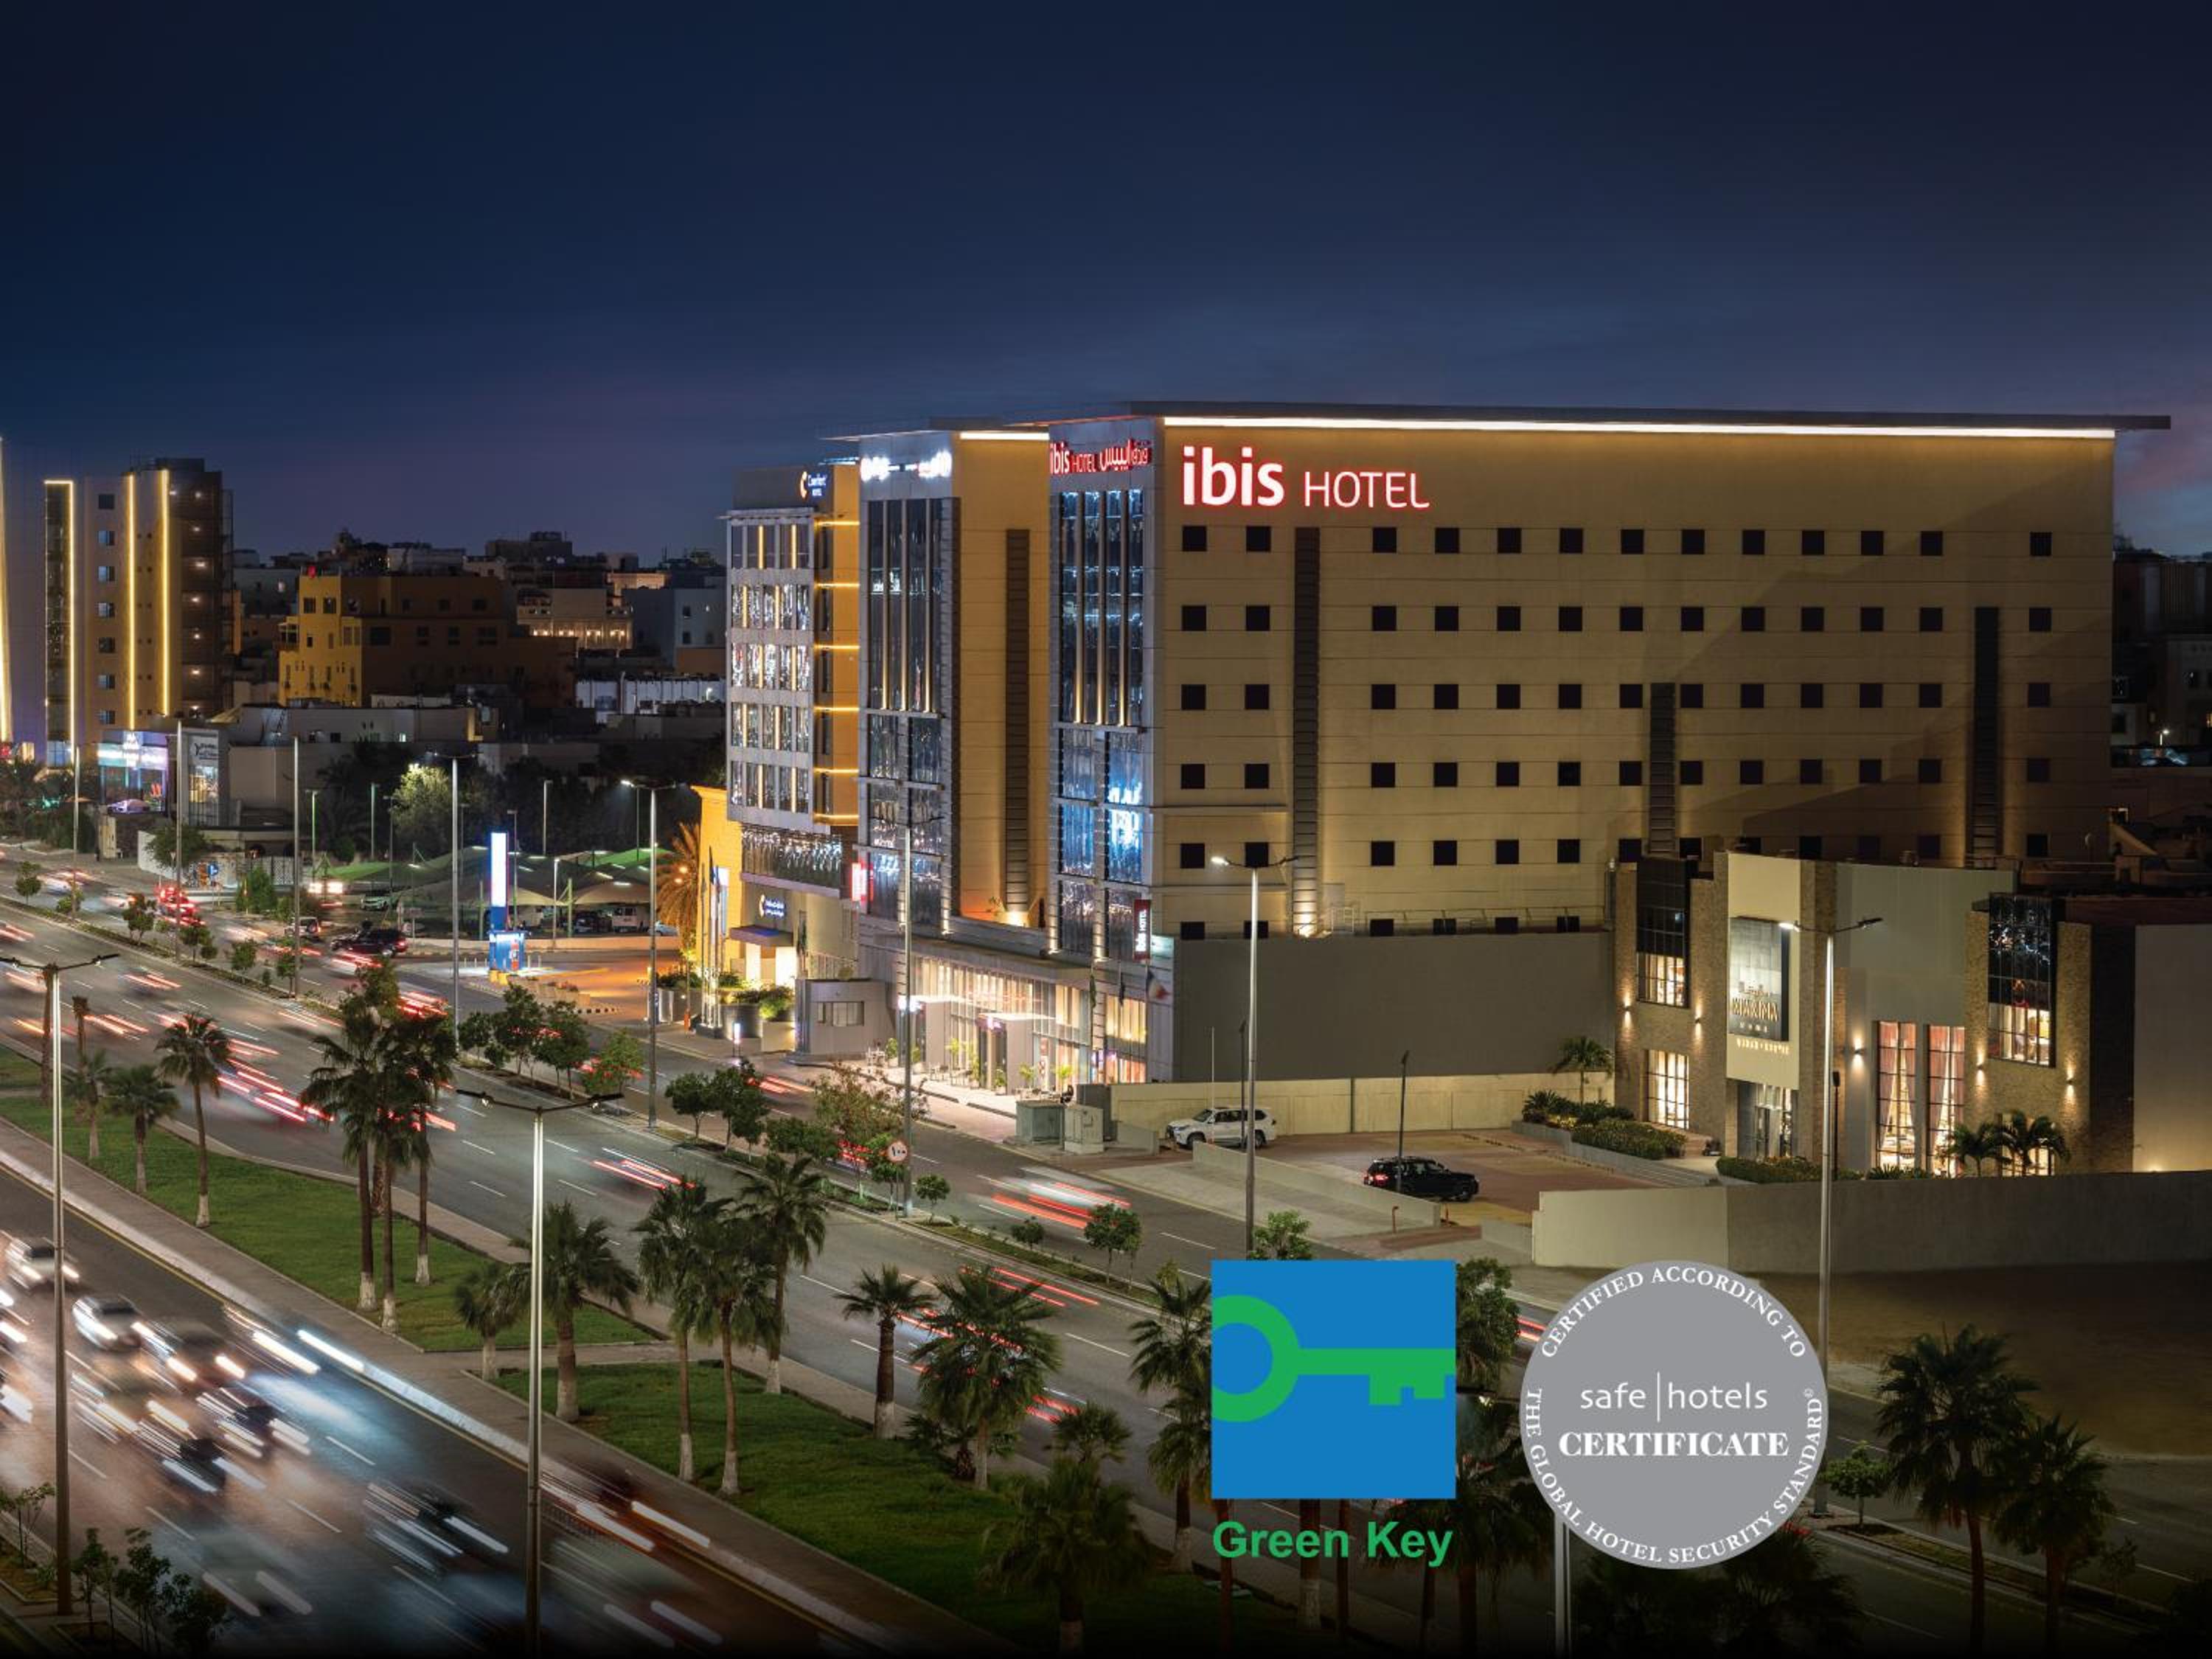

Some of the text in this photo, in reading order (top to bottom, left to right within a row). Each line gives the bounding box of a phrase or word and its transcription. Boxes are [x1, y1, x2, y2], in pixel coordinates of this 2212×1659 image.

[1049, 441, 1096, 474] ibis HOTEL
[1183, 445, 1430, 509] ibis HOTEL
